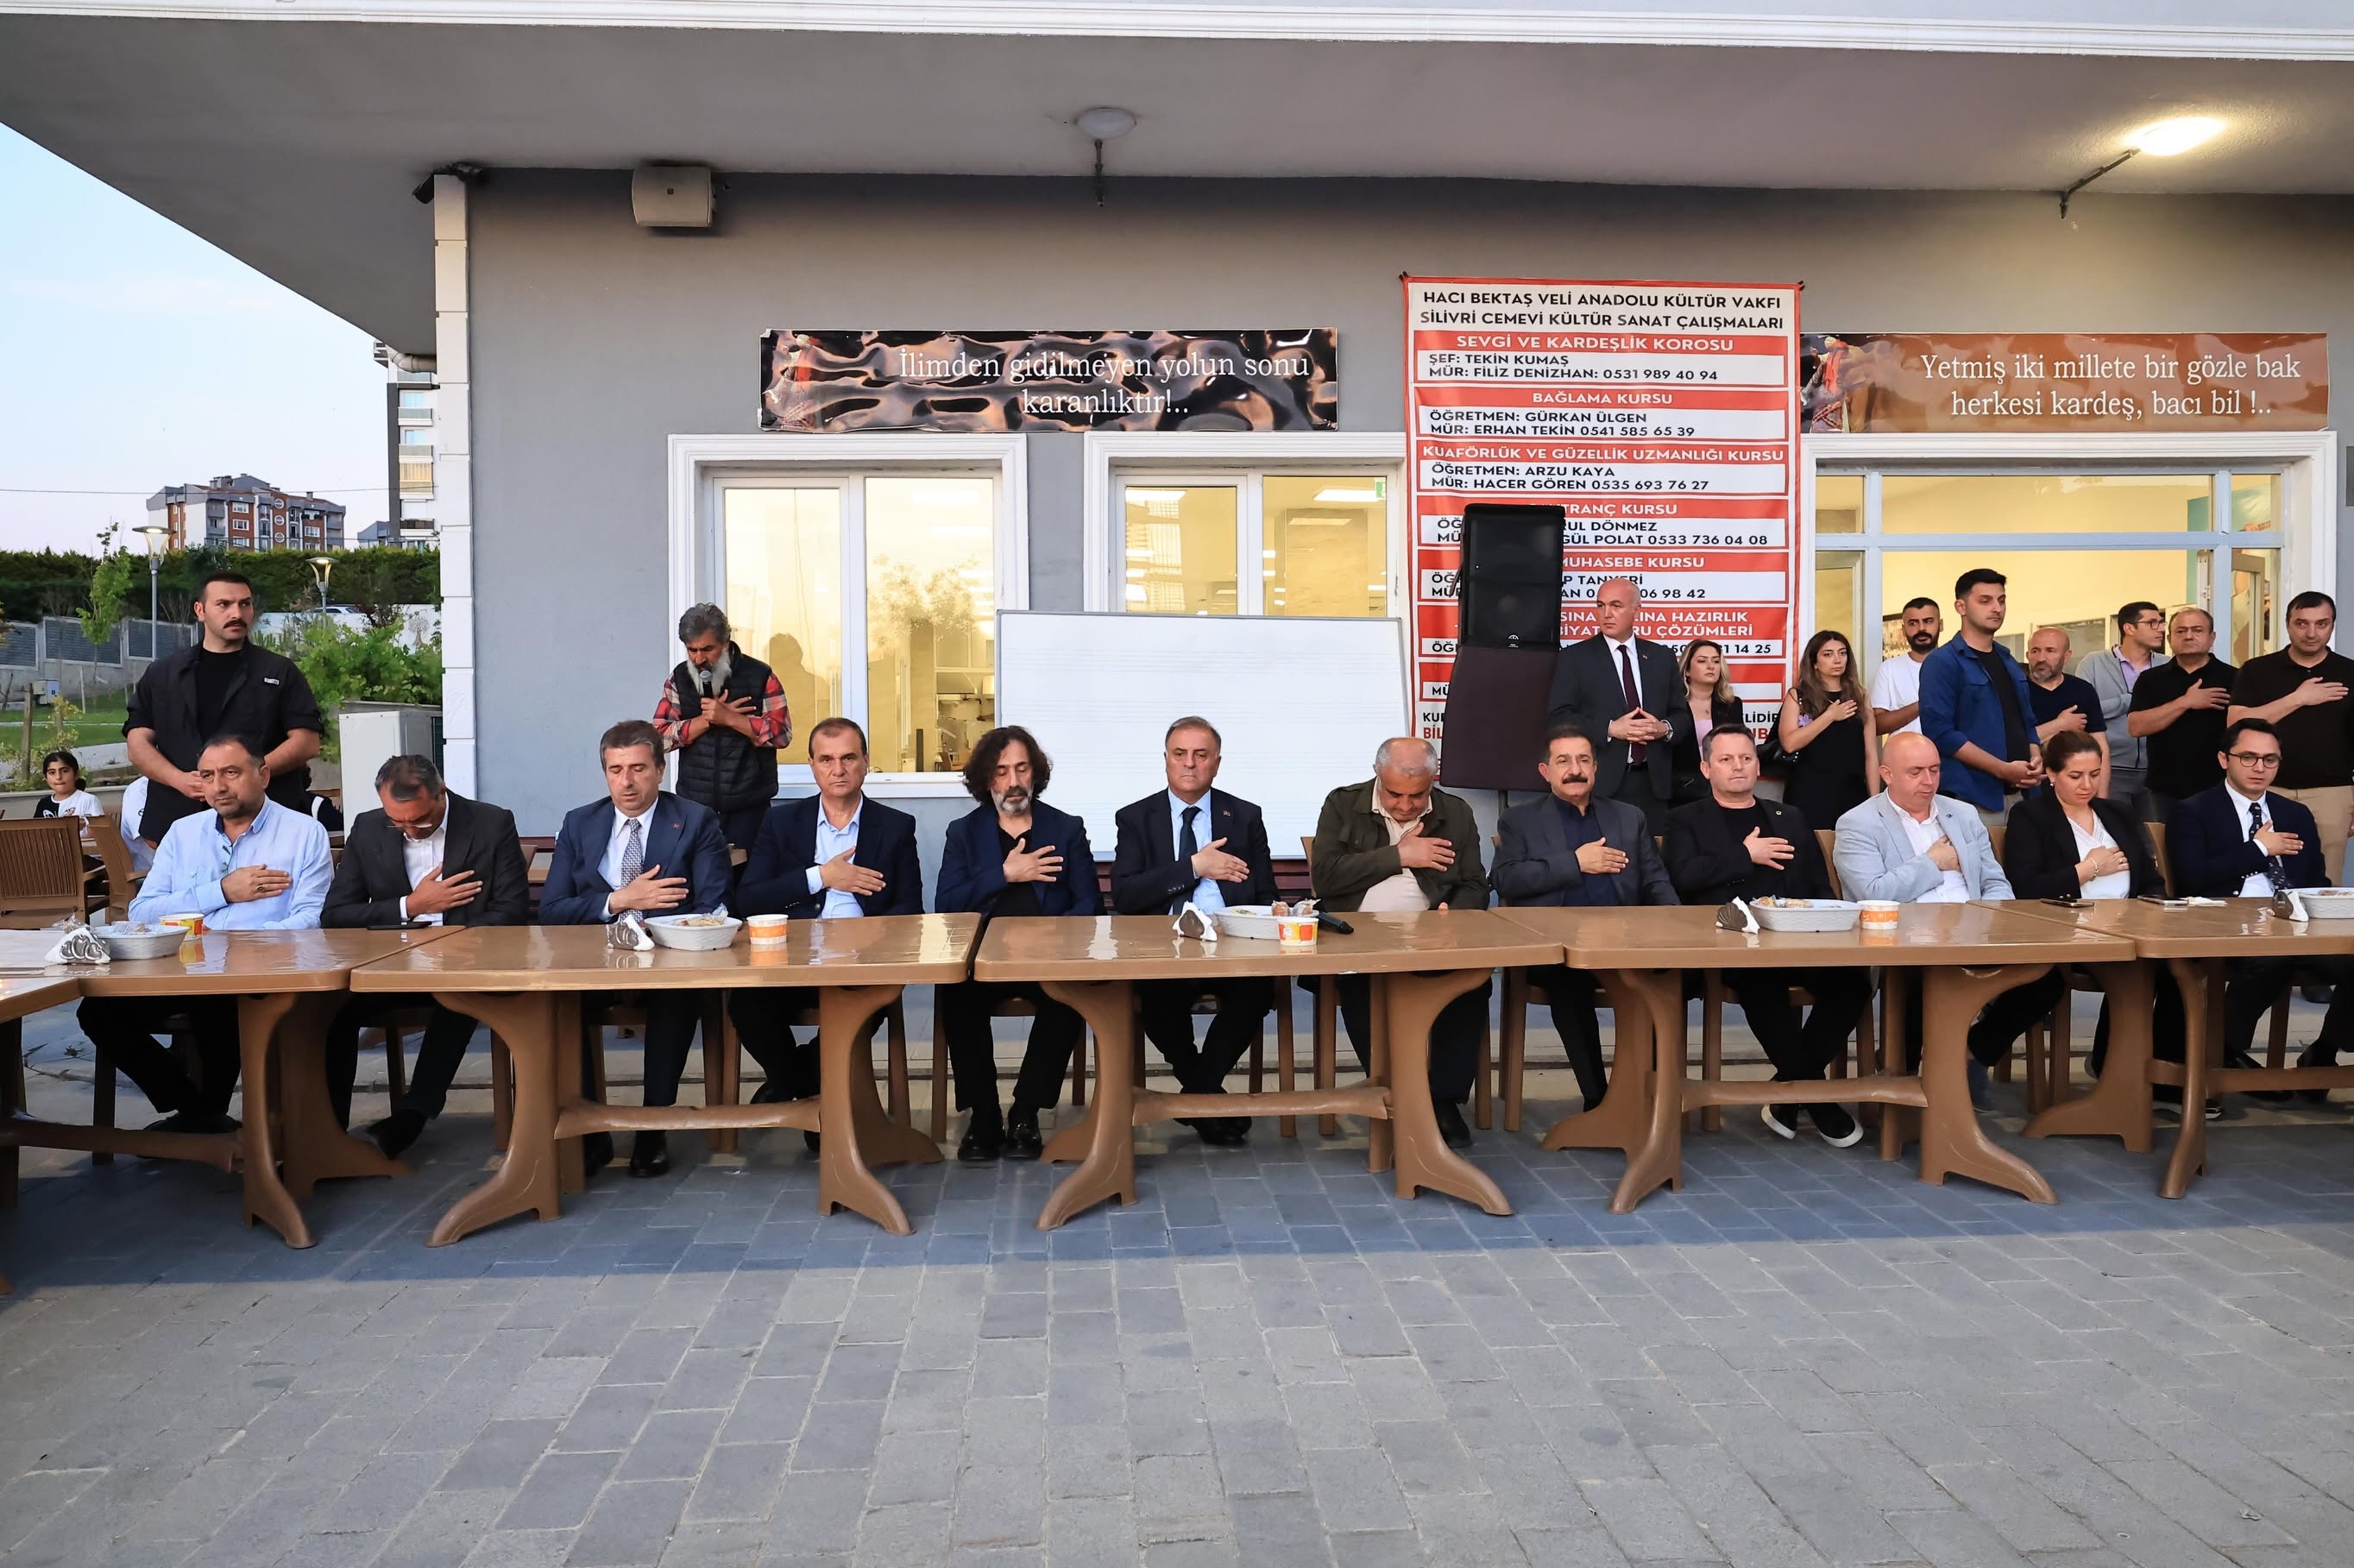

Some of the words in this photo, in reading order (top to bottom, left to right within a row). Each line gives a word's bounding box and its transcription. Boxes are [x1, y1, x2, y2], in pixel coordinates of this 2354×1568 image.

[1424, 292, 1465, 304] HACI
[1470, 292, 1533, 307] BEKTAŞ
[1539, 291, 1572, 305] VELİ
[1577, 293, 1658, 306] ANADOLU
[1664, 293, 1727, 308] KÜLTÜR
[1732, 296, 1781, 309] VAKFI
[1420, 309, 1476, 324] SİLİVRİ
[1482, 311, 1544, 324] CEMEVİ
[1549, 312, 1612, 325] KÜLTÜR
[1617, 314, 1671, 327] SANAT
[1677, 315, 1784, 331] ÇALIŞMALARI
[1457, 333, 1511, 348] SEVGİ
[1517, 336, 1540, 348] VE
[1546, 335, 1648, 352] KARDEŞLİK
[1653, 338, 1734, 351] KOROSU
[899, 348, 1001, 377] İlimden
[1010, 351, 1153, 384] gidilmeyen
[1160, 351, 1236, 383] yolun
[1244, 357, 1310, 376] sonu
[1429, 354, 1460, 366] ŞEF:
[1465, 353, 1508, 364] TEKİN
[1514, 355, 1569, 367] KUMAŞ
[1429, 365, 1469, 377] MÜR:
[1474, 366, 1508, 377] FİLİZ
[1514, 367, 1598, 379] DENİZHAN:
[1603, 368, 1638, 379] 0531
[1643, 369, 1671, 380] 989
[1676, 370, 1695, 381] 40
[1699, 371, 1718, 381] 94
[1921, 354, 2006, 385] Yetmiş
[2014, 354, 2045, 379] iki
[2054, 354, 2136, 379] millete
[2144, 354, 2179, 379] bir
[2187, 354, 2247, 386] gözle
[2255, 354, 2301, 378] bak
[1022, 388, 1188, 413] karanlıktır!..
[1533, 391, 1612, 404] BAĞLAMA
[1617, 394, 1672, 404] KURSU
[1951, 390, 2042, 415] herkesi
[2050, 390, 2143, 421] kardeş,
[2151, 390, 2202, 415] bacı
[2211, 390, 2242, 414] bil
[1430, 409, 1520, 422] ÖĞRETMEN:
[1525, 410, 1591, 422] GÜRKAN
[1596, 412, 1646, 423] ÜLGEN
[1431, 423, 1469, 434] MÜR:
[1474, 425, 1526, 435] ERHAN
[1532, 424, 1575, 435] TEKİN
[1580, 425, 1614, 436] 0541
[1620, 426, 1647, 437] 585
[1653, 426, 1672, 437] 65
[1677, 427, 1695, 437] 39
[1423, 445, 1521, 459] KUAFÖRLÜK
[1526, 449, 1547, 459] VE
[1552, 447, 1628, 460] GÜZELLİK
[1633, 448, 1723, 461] UZMANLIĞI
[1728, 450, 1784, 461] KURSU
[1432, 462, 1520, 475] ÖĞRETMEN:
[1525, 466, 1567, 476] ARZU
[1572, 467, 1615, 476] KAYA
[1432, 476, 1468, 488] MÜR:
[1473, 479, 1526, 489] HACER
[1532, 478, 1586, 489] GÖREN
[1591, 480, 1630, 490] 0535
[1634, 480, 1663, 490] 693
[1668, 480, 1687, 490] 76
[1691, 481, 1709, 490] 27
[1563, 504, 1616, 516] TRANÇ
[1621, 504, 1677, 514] KURSU
[1591, 520, 1658, 532] DÖNMEZ
[1438, 531, 1461, 542] MÜ
[1595, 535, 1644, 545] POLAT
[1647, 535, 1687, 545] 0533
[1692, 535, 1720, 545] 736
[1724, 535, 1743, 545] 04
[1748, 536, 1768, 545] 08
[1647, 557, 1705, 568] KURSU
[1662, 589, 1682, 599] 98
[1686, 589, 1706, 599] 42
[1671, 611, 1748, 622] HAZIRLIK
[1656, 624, 1753, 639] ÇÖZÜMLERİ
[1734, 644, 1749, 654] 14
[1754, 644, 1772, 654] 25
